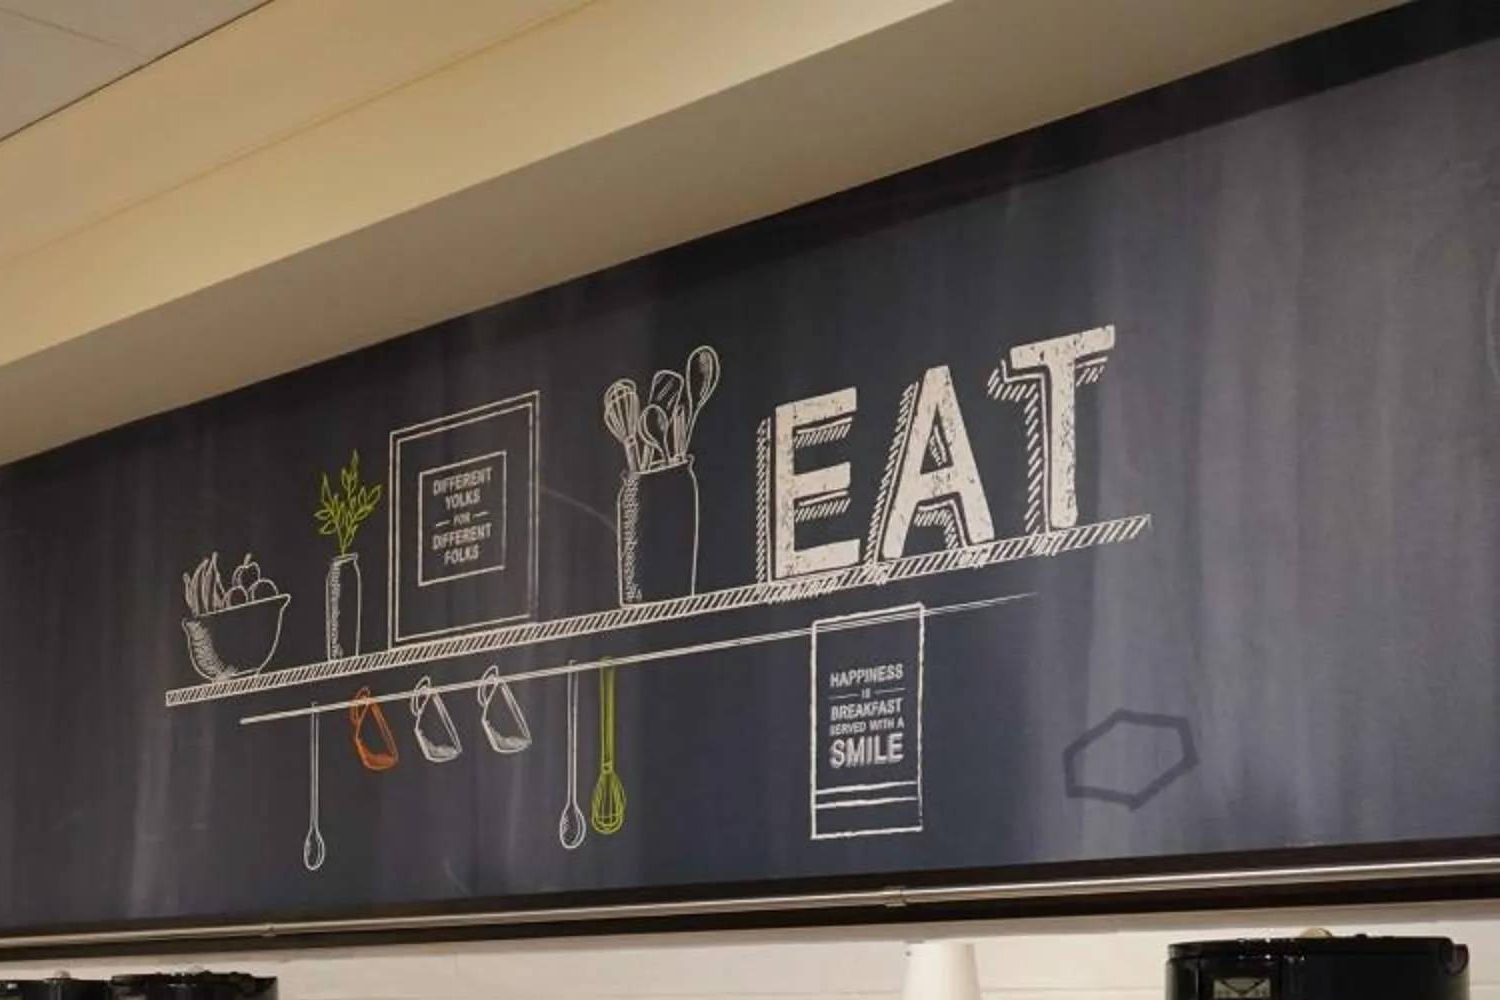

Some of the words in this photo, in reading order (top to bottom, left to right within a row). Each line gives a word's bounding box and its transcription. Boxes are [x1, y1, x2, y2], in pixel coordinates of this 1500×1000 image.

[760, 324, 1115, 581] EAT
[432, 467, 493, 496] DIFFERENT
[444, 488, 481, 511] YOLKS
[432, 522, 493, 551] DIFFERENT
[443, 545, 480, 566] FOLKS
[829, 663, 904, 688] HAPPINESS
[830, 697, 904, 721] BREAKFAST
[869, 718, 895, 732] WITH
[829, 733, 904, 769] SMILE
